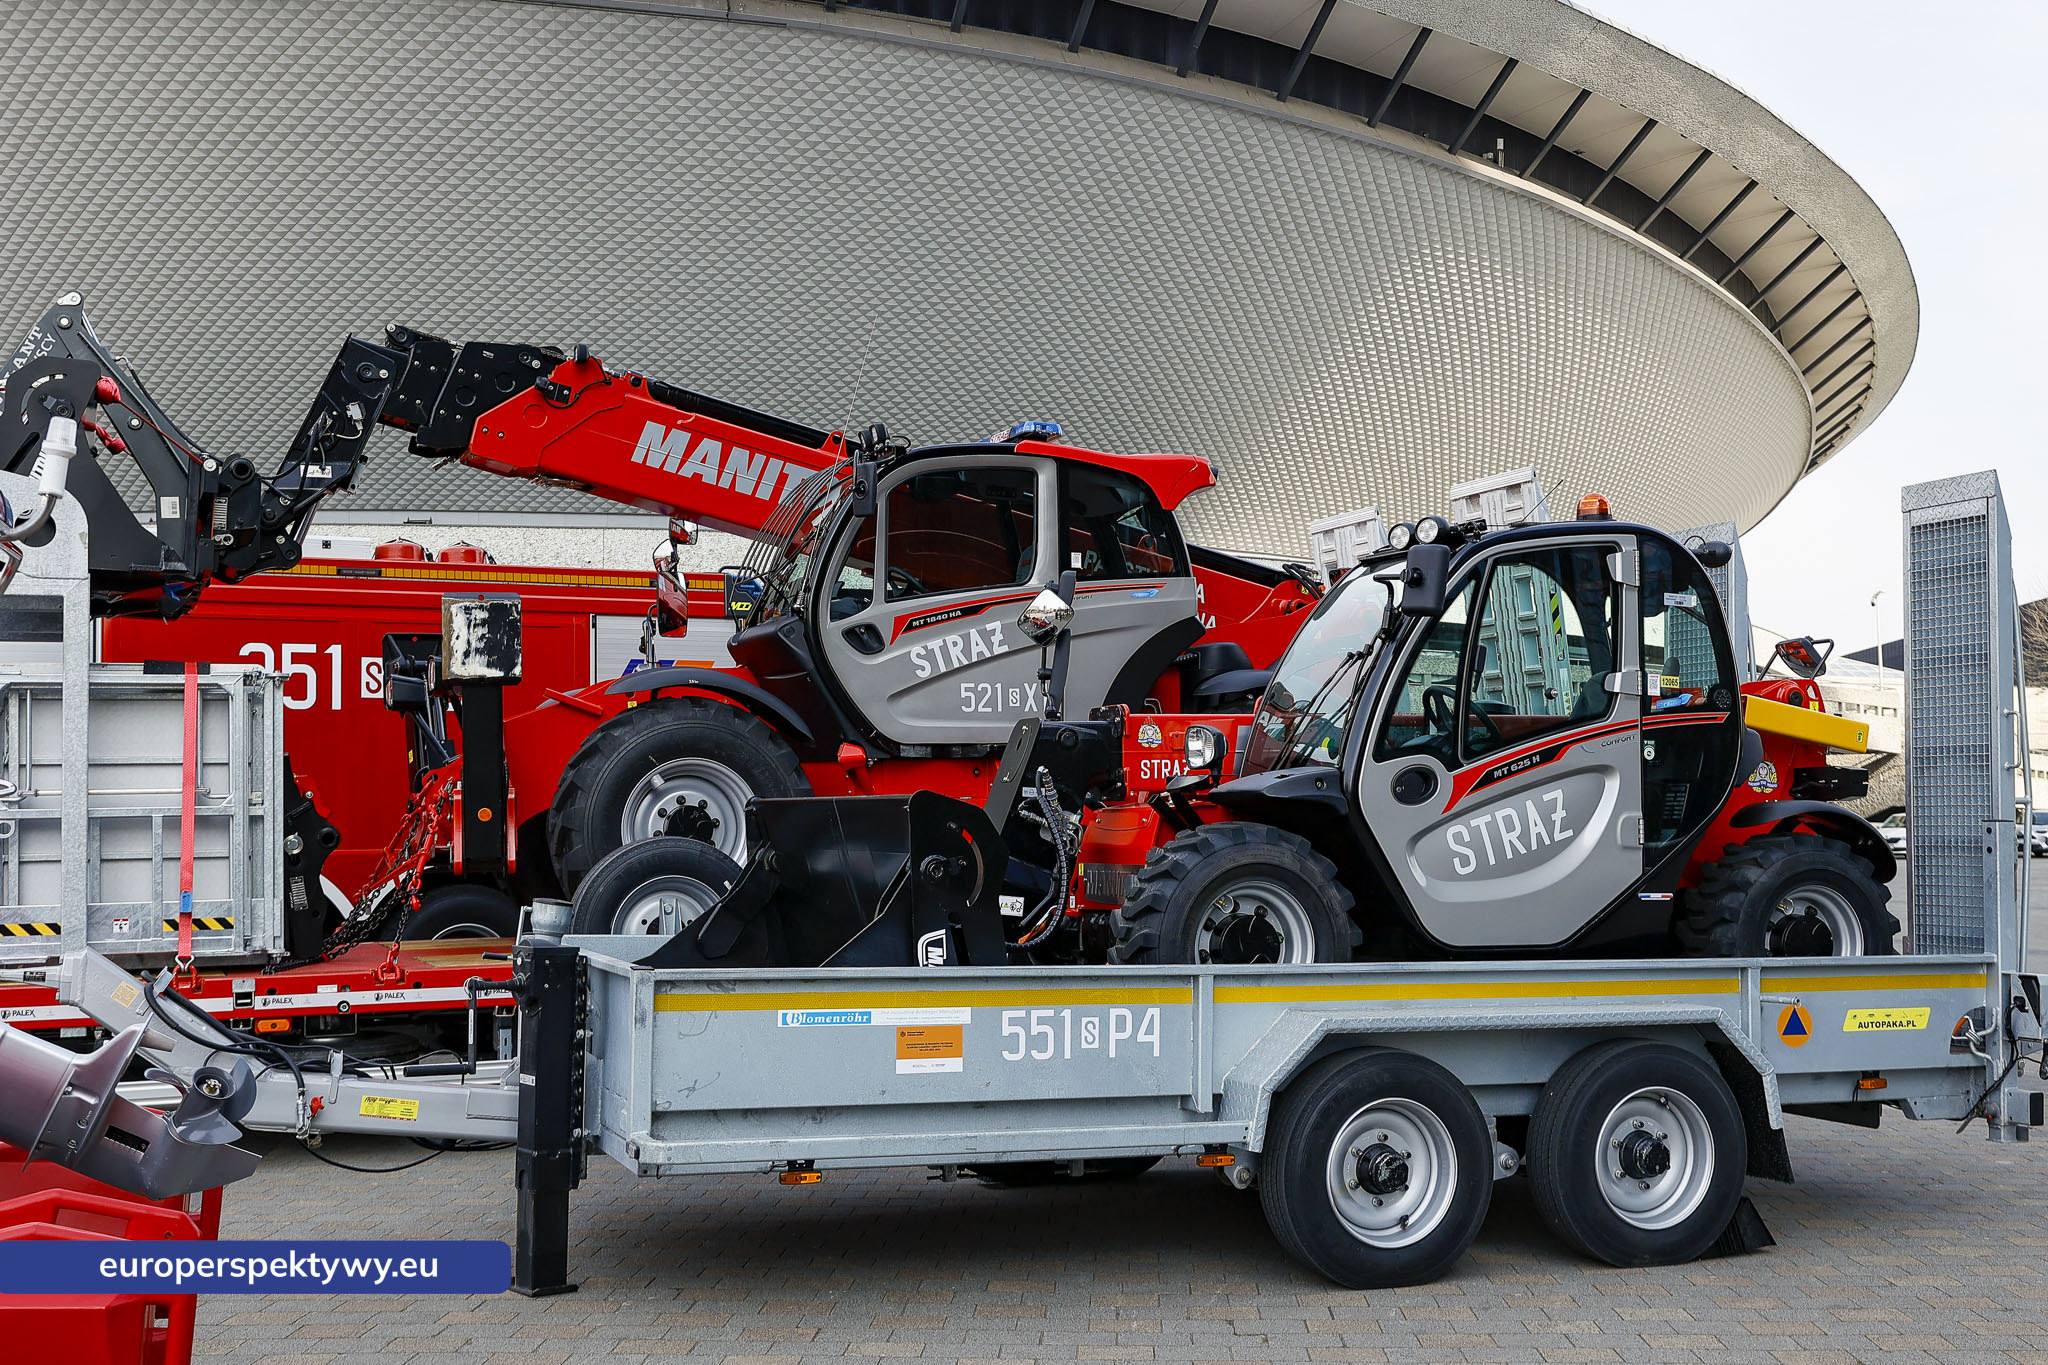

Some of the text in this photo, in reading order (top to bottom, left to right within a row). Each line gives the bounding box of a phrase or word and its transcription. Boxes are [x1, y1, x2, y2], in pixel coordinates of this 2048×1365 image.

[912, 610, 962, 627] MT 1840 HA
[909, 620, 1010, 678] STRAŻ
[363, 659, 382, 696] S
[960, 682, 1002, 712] 521
[1010, 690, 1019, 705] S
[1493, 754, 1541, 778] MT 625 H
[1446, 788, 1574, 876] STRAŻ
[271, 997, 294, 1005] PALEX
[384, 991, 406, 1000] PALEX
[12, 1009, 36, 1018] PALEX
[786, 1012, 869, 1026] Blomenröhr
[1001, 1007, 1161, 1061] 551 S P4
[1857, 1020, 1917, 1029] AUTOPAKA.PL
